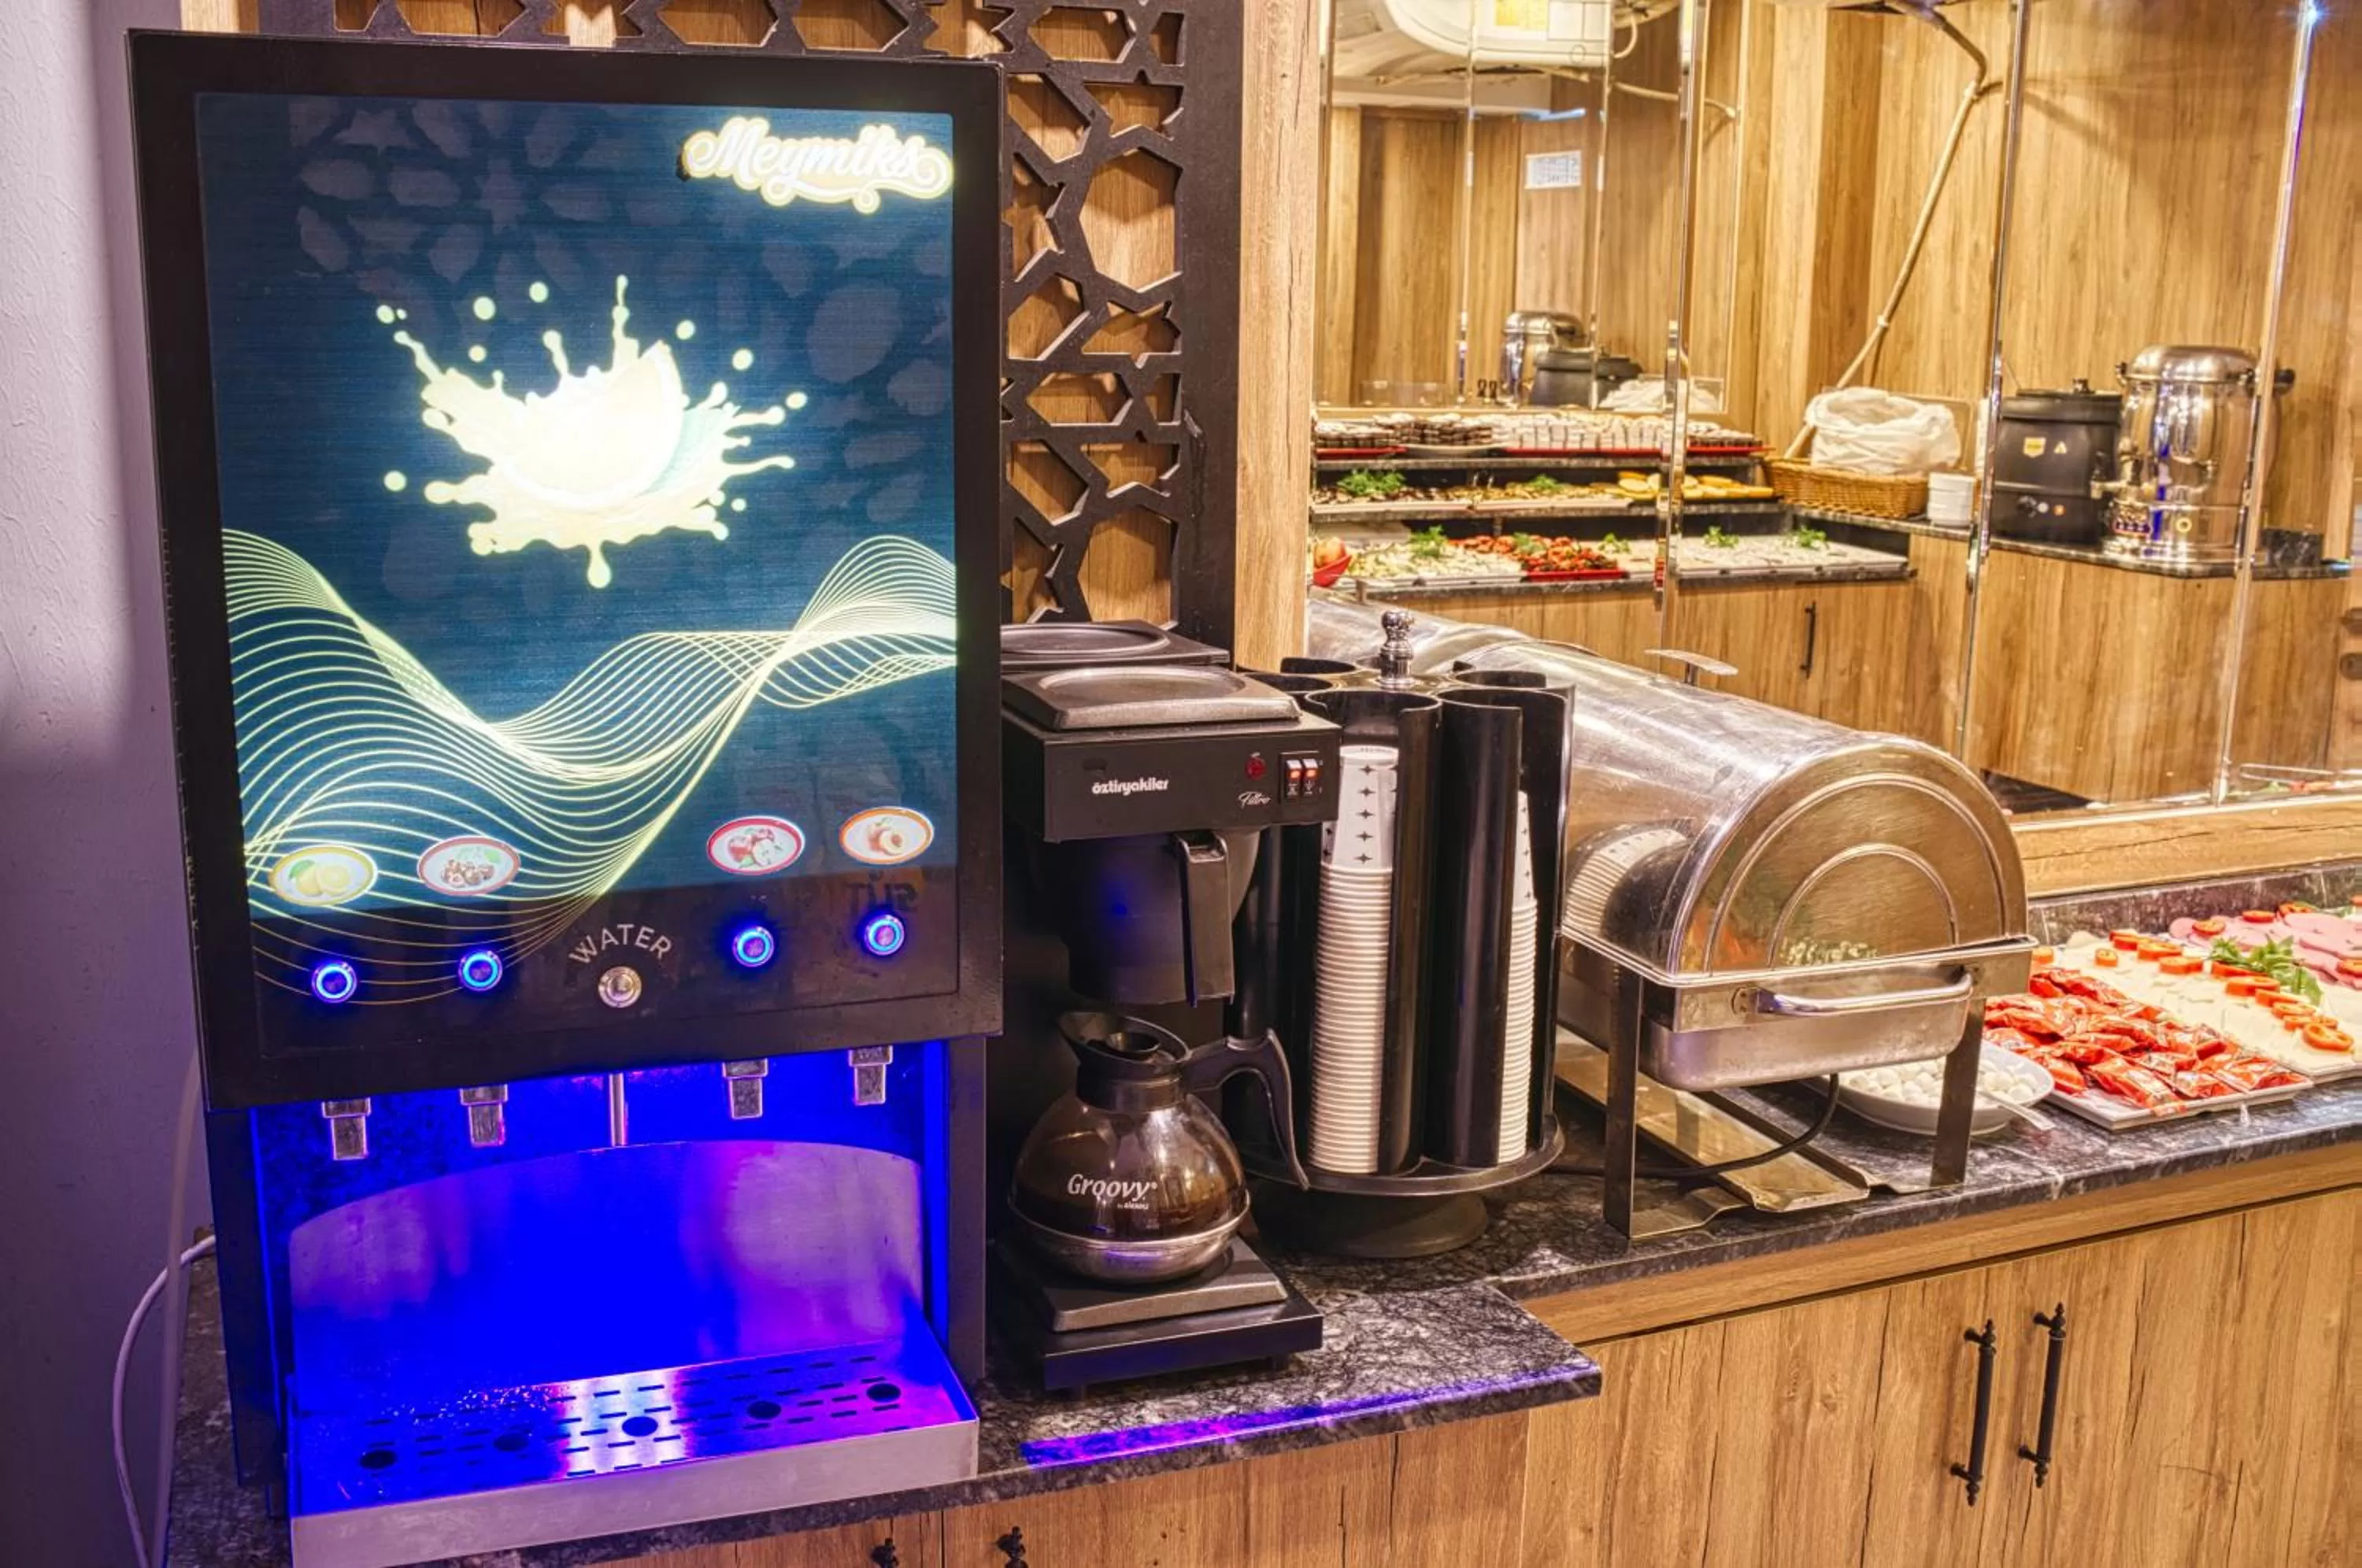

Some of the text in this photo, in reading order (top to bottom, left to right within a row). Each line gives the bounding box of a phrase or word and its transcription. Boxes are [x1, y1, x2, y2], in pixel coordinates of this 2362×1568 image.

[683, 117, 953, 212] Meymiks
[1091, 777, 1169, 796] öztiryakiler
[568, 923, 672, 963] WATER
[1068, 1174, 1150, 1201] Groovy
